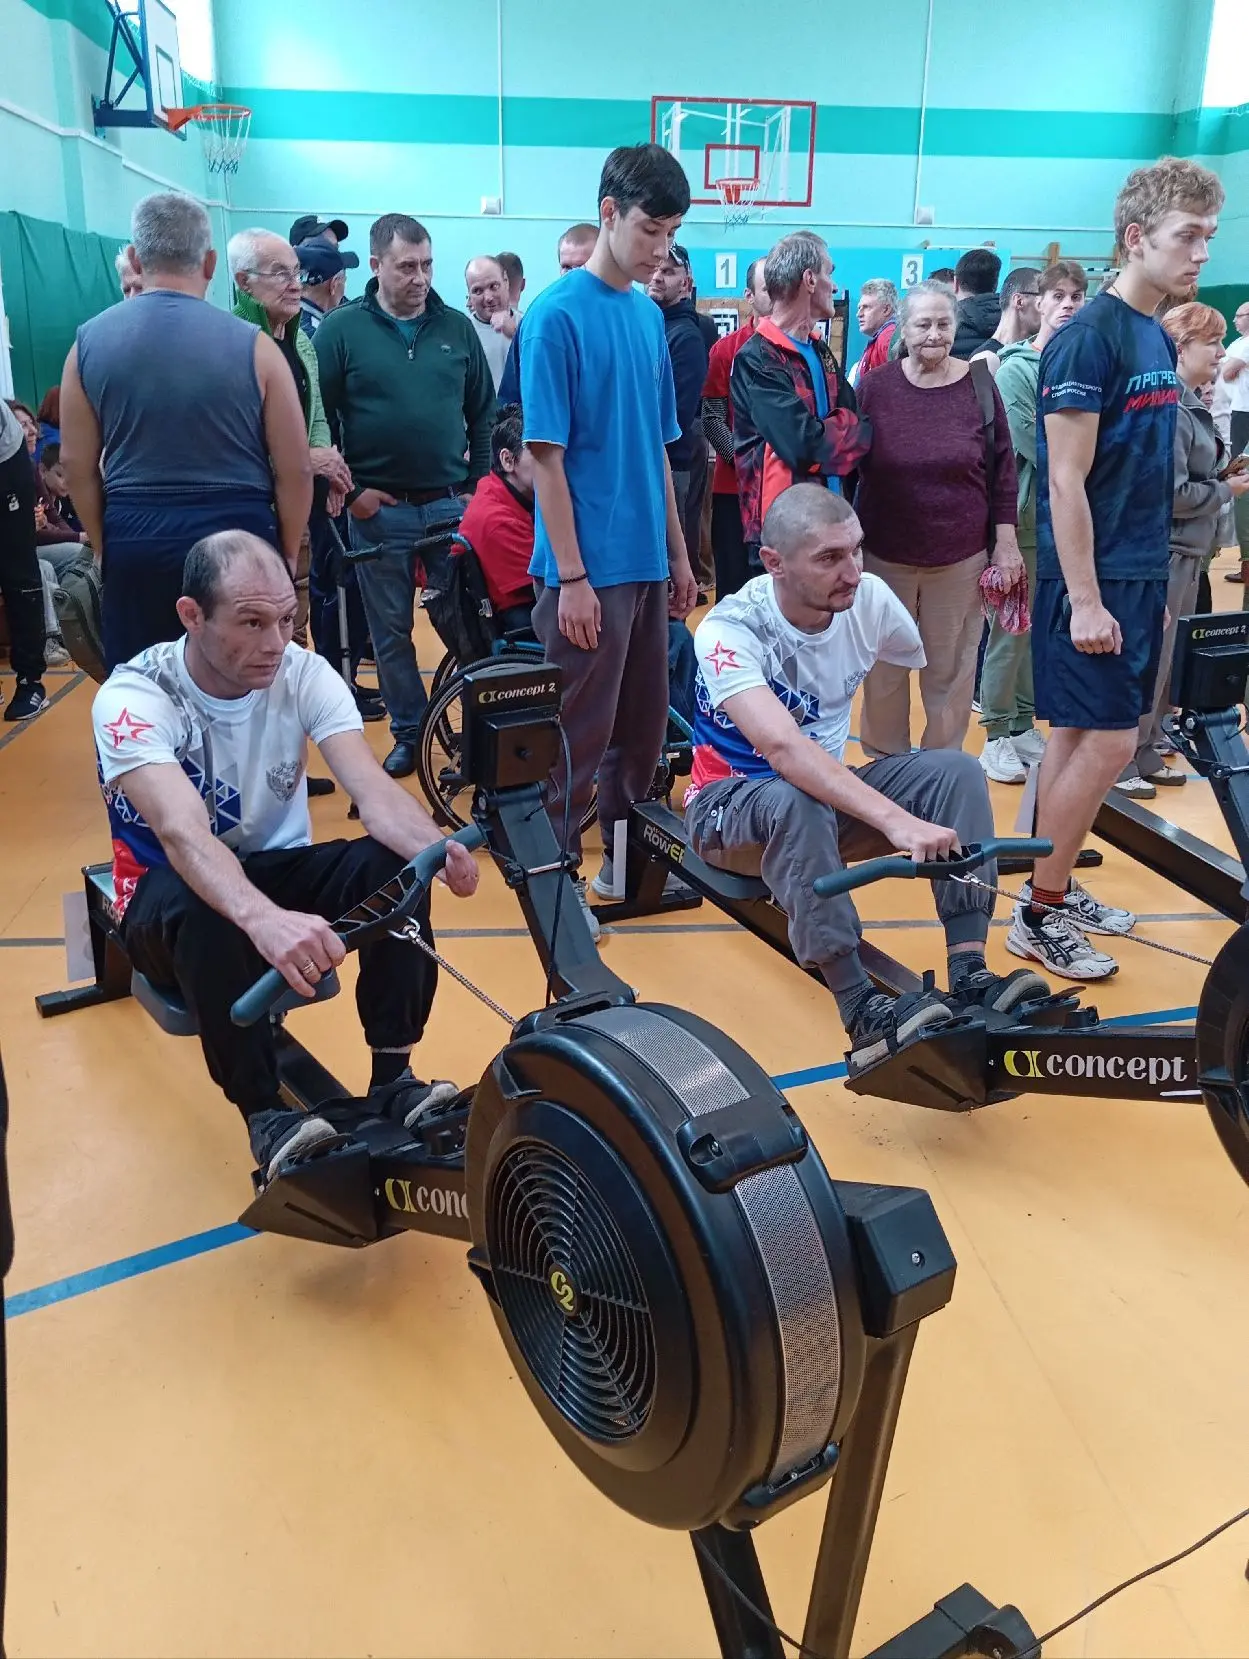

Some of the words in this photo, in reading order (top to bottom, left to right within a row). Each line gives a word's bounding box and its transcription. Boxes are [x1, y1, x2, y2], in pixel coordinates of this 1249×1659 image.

[720, 258, 730, 286] 1
[905, 260, 919, 287] 3
[1205, 626, 1240, 638] concept
[1240, 624, 1247, 633] 2
[497, 683, 546, 701] concept
[548, 682, 556, 692] 2
[1046, 1053, 1188, 1085] concept
